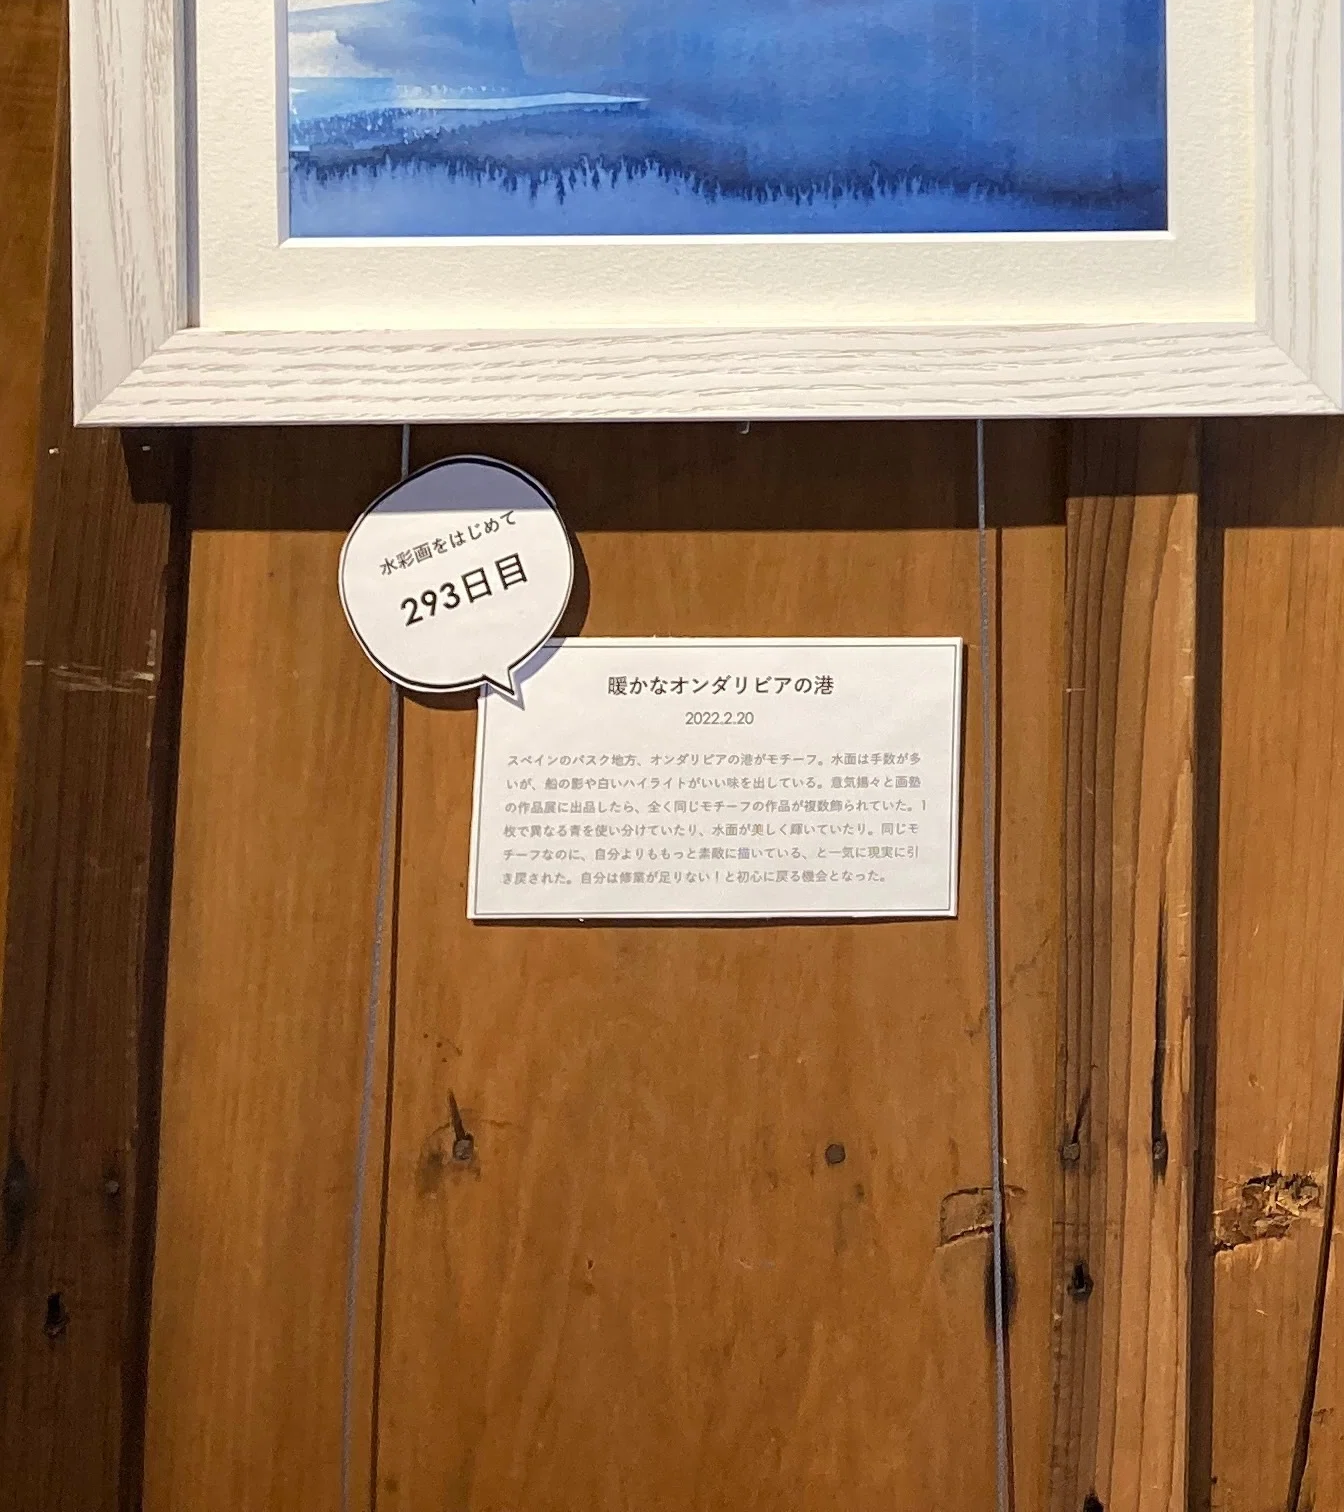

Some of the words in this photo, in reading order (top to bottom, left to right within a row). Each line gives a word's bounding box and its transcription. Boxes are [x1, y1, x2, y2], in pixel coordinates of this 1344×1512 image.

[379, 509, 517, 577] 水彩画をはじめて
[400, 552, 529, 628] 293日目
[607, 674, 835, 696] 暖かなオンダリビアの港
[684, 710, 755, 726] 2022.2.20
